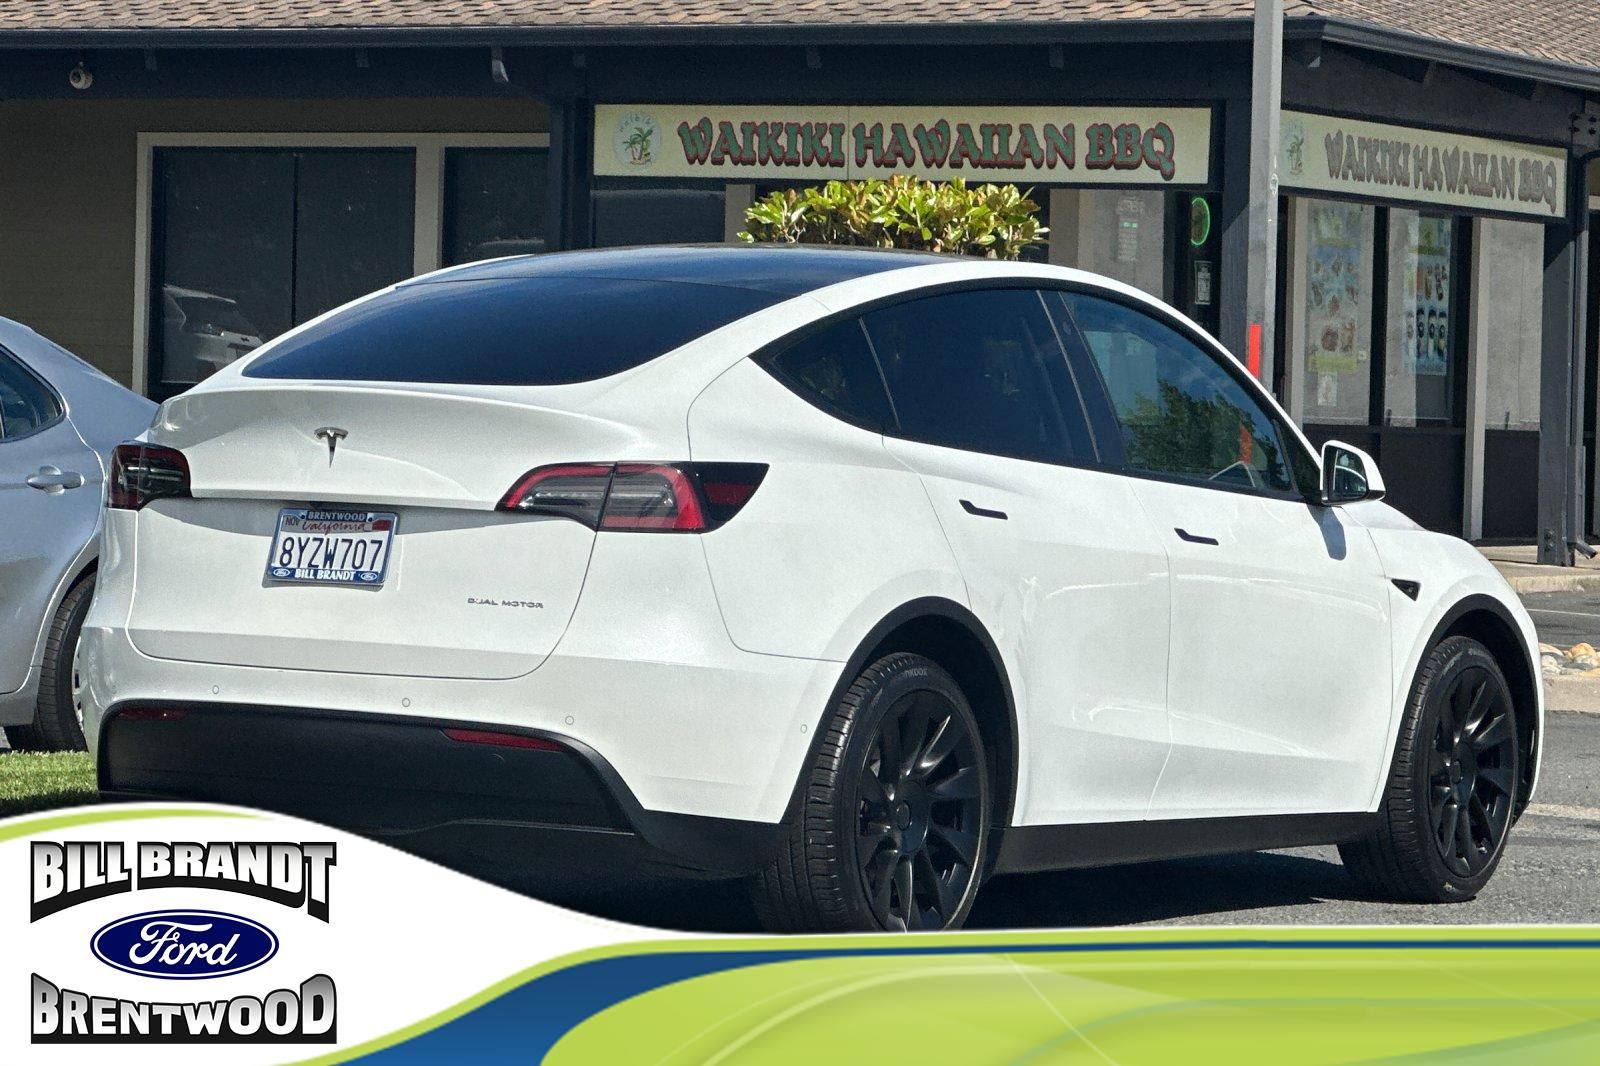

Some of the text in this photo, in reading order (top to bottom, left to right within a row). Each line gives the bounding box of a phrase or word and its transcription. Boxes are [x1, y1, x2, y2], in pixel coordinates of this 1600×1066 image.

[677, 117, 845, 167] WAIKIKI
[853, 118, 1075, 170] HAWAIIAN
[1085, 121, 1175, 181] BBQ
[1324, 129, 1557, 214] WAIKIKI HAWAIIAN BBQ
[285, 517, 299, 527] NOV
[308, 511, 367, 521] BRENTWOOD
[302, 520, 365, 535] California
[280, 536, 383, 570] 8YZW707
[294, 568, 315, 579] BILL
[317, 569, 357, 580] BRANDT
[501, 599, 544, 609] MOTOR
